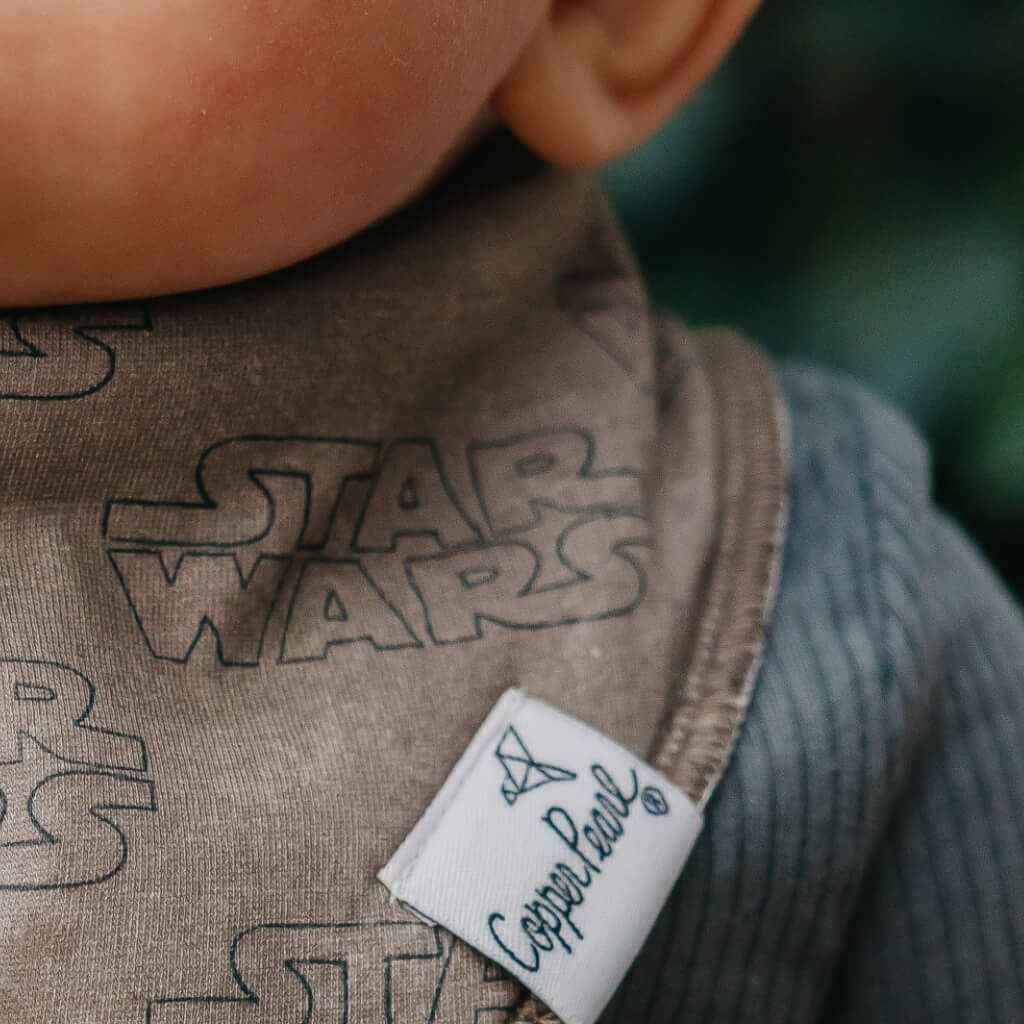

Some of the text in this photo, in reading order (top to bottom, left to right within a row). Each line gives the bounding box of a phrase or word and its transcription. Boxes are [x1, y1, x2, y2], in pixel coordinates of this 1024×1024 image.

[102, 424, 652, 553] STAR
[107, 508, 656, 668] WARS
[487, 861, 593, 973] Copper
